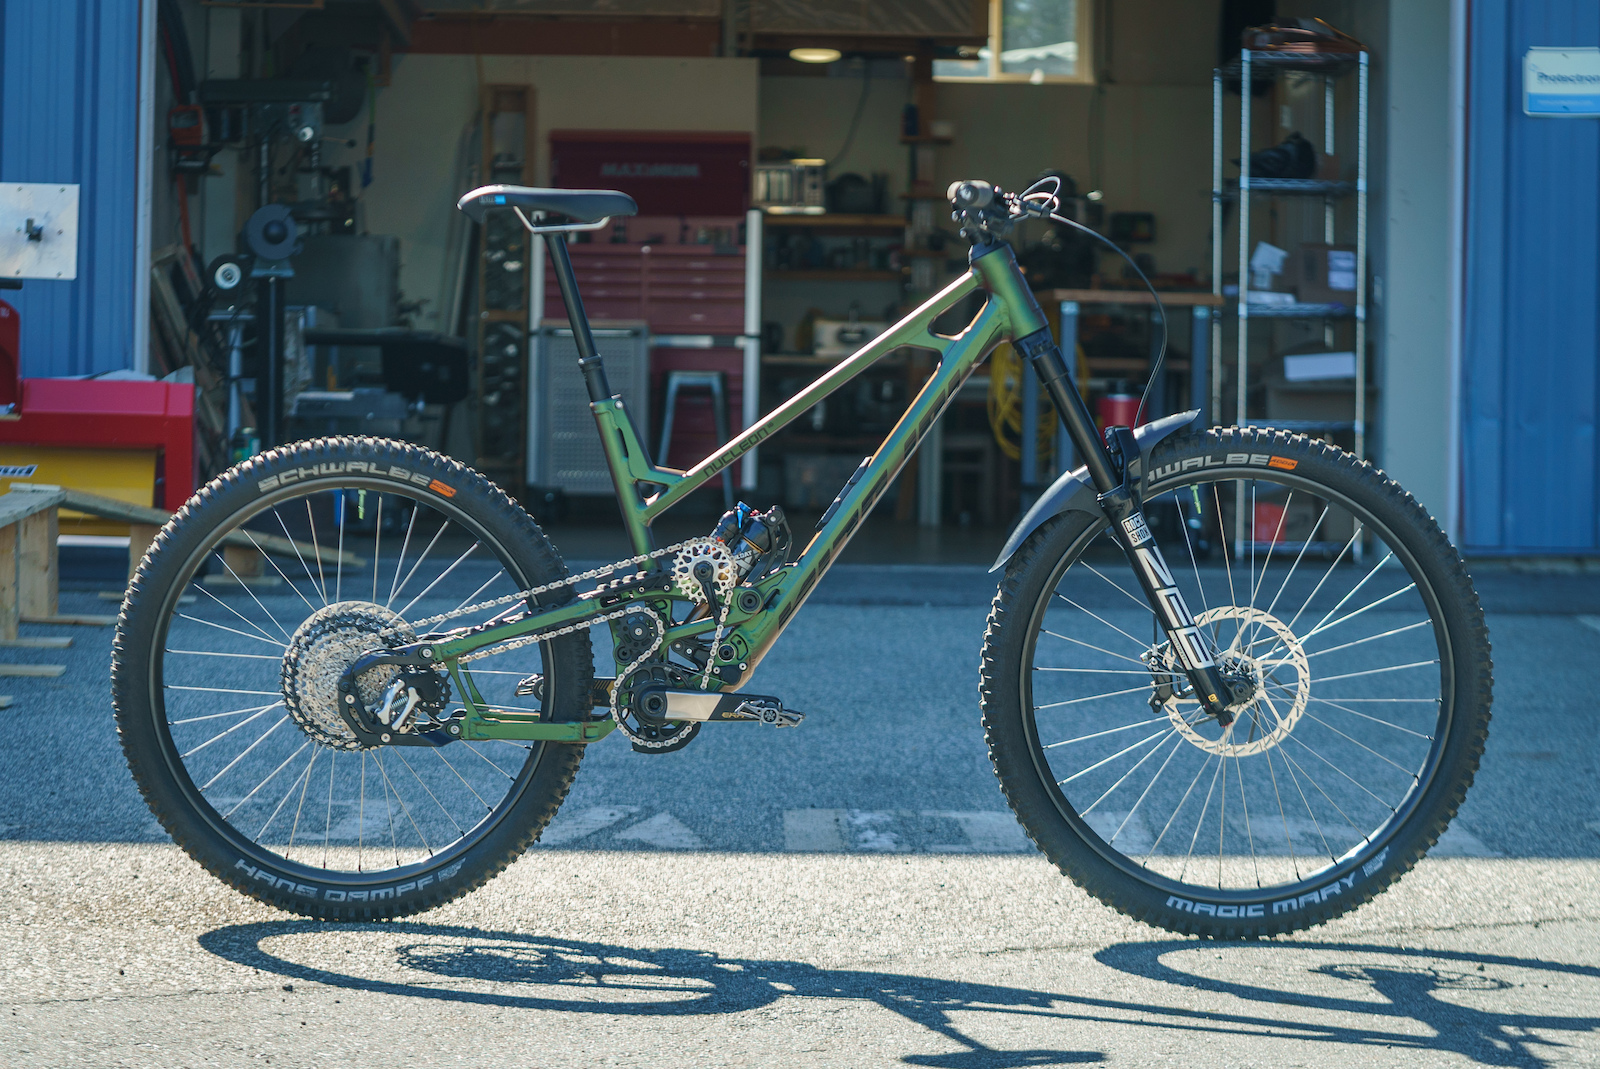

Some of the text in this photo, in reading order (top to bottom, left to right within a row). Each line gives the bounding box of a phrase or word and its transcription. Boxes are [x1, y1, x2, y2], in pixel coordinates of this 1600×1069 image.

[258, 461, 431, 493] SCHWALBE
[1125, 513, 1145, 532] ROCK
[234, 858, 434, 902] HANS DAMPF
[1166, 872, 1356, 918] MAGIC MARY
